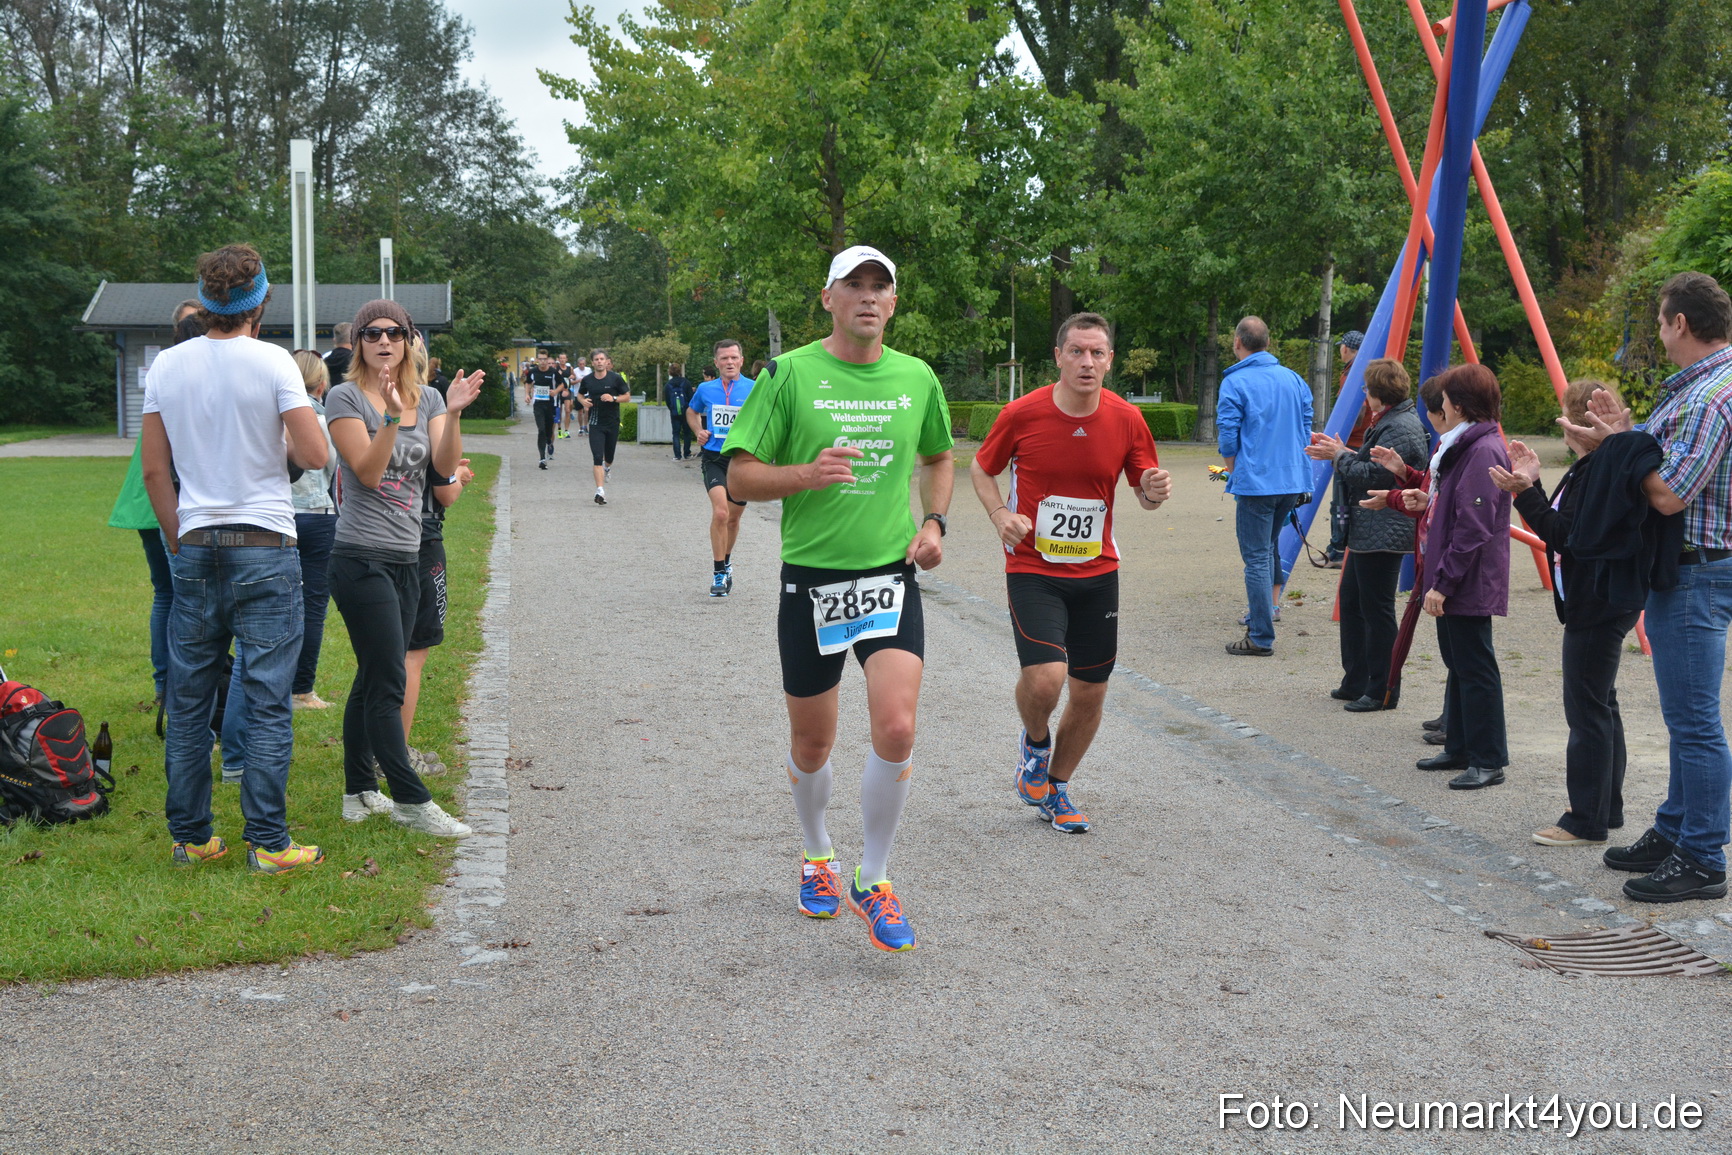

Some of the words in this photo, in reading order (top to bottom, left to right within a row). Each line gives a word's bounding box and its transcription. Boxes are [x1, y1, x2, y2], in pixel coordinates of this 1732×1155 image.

[813, 399, 897, 410] SCHMINKE
[830, 412, 892, 424] Weltenburger
[832, 436, 894, 449] CONRAD
[1040, 500, 1065, 510] PARTL
[1066, 504, 1098, 512] Neumarkt
[1050, 513, 1094, 539] 293
[1049, 543, 1088, 555] Matthias
[822, 588, 895, 622] 2850
[844, 619, 875, 640] Jürgen
